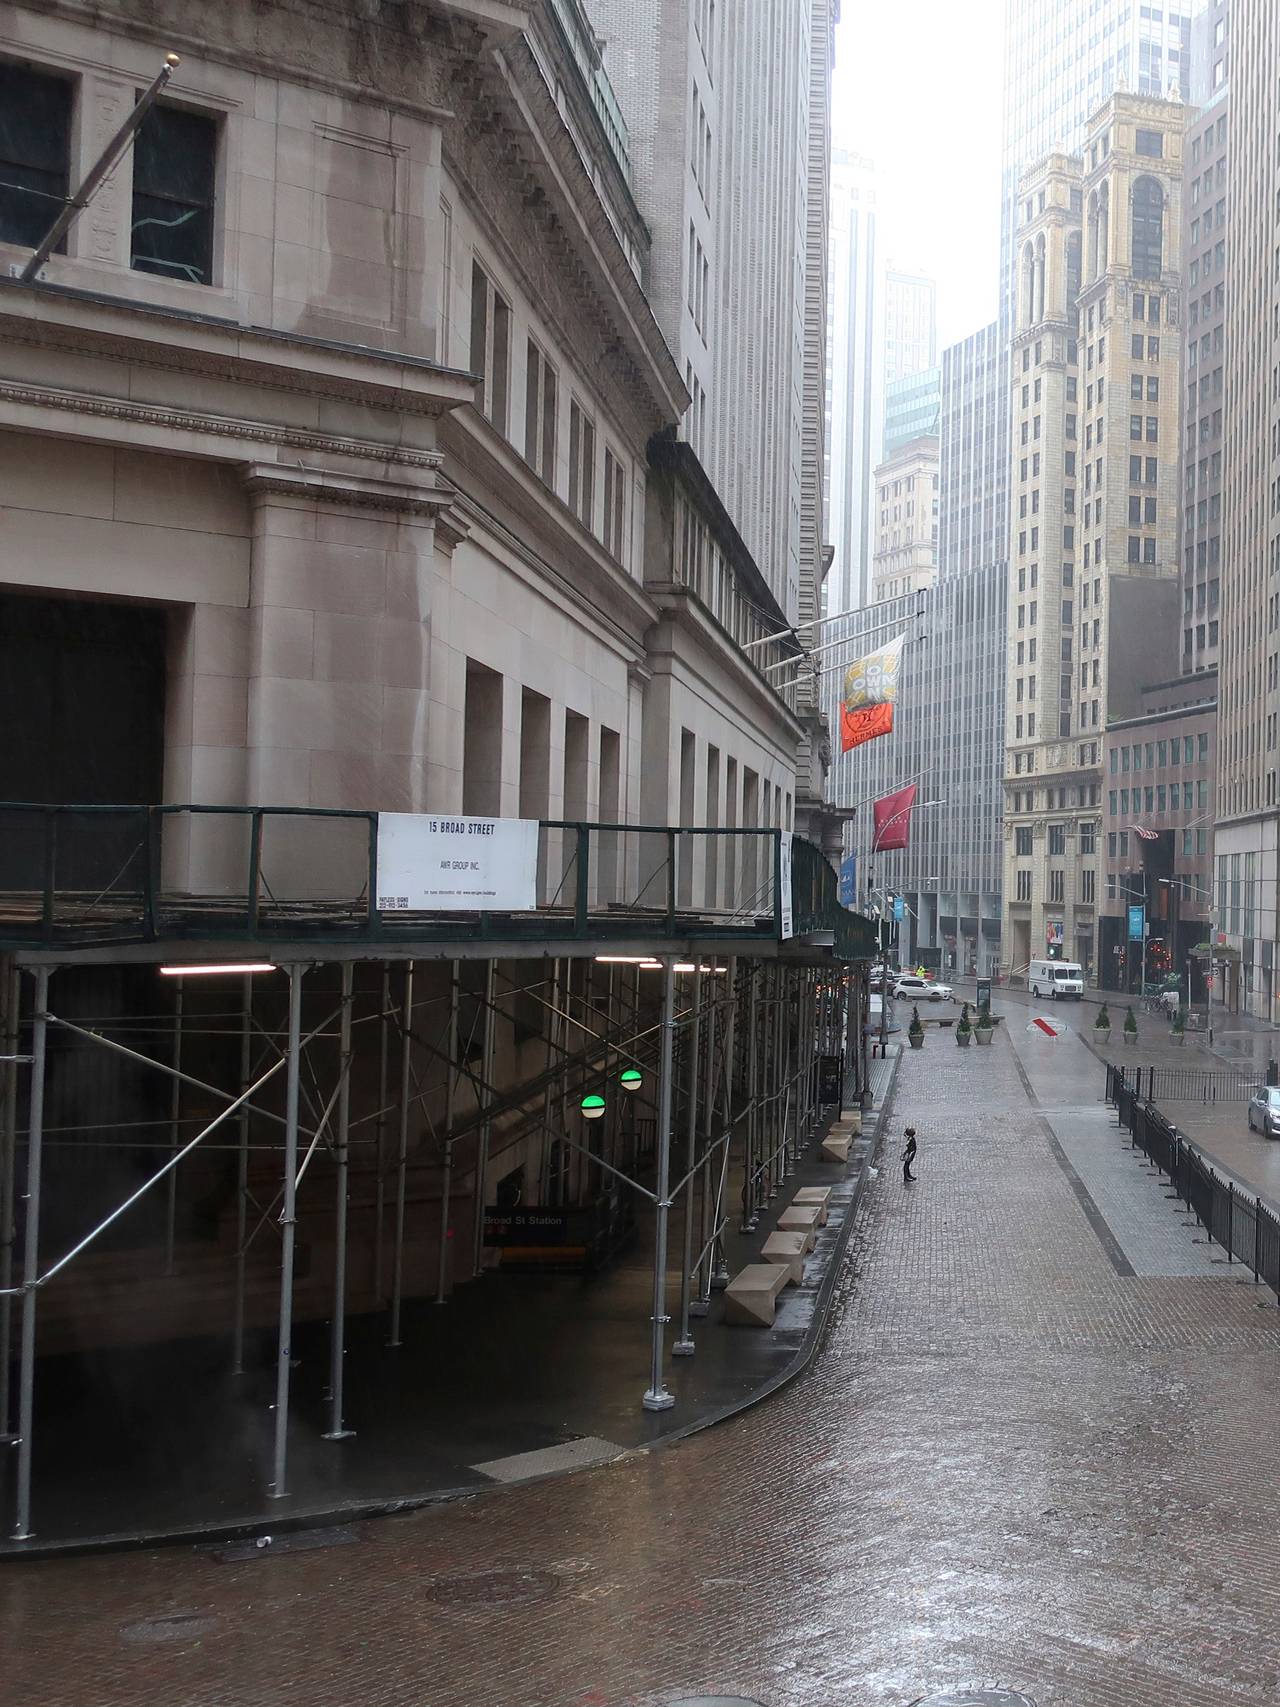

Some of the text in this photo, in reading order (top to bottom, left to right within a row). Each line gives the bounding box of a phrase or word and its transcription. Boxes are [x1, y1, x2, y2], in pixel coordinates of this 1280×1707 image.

[429, 821, 495, 835] 15 BROAD STREET
[515, 1215, 525, 1225] St
[528, 1215, 562, 1225] Station
